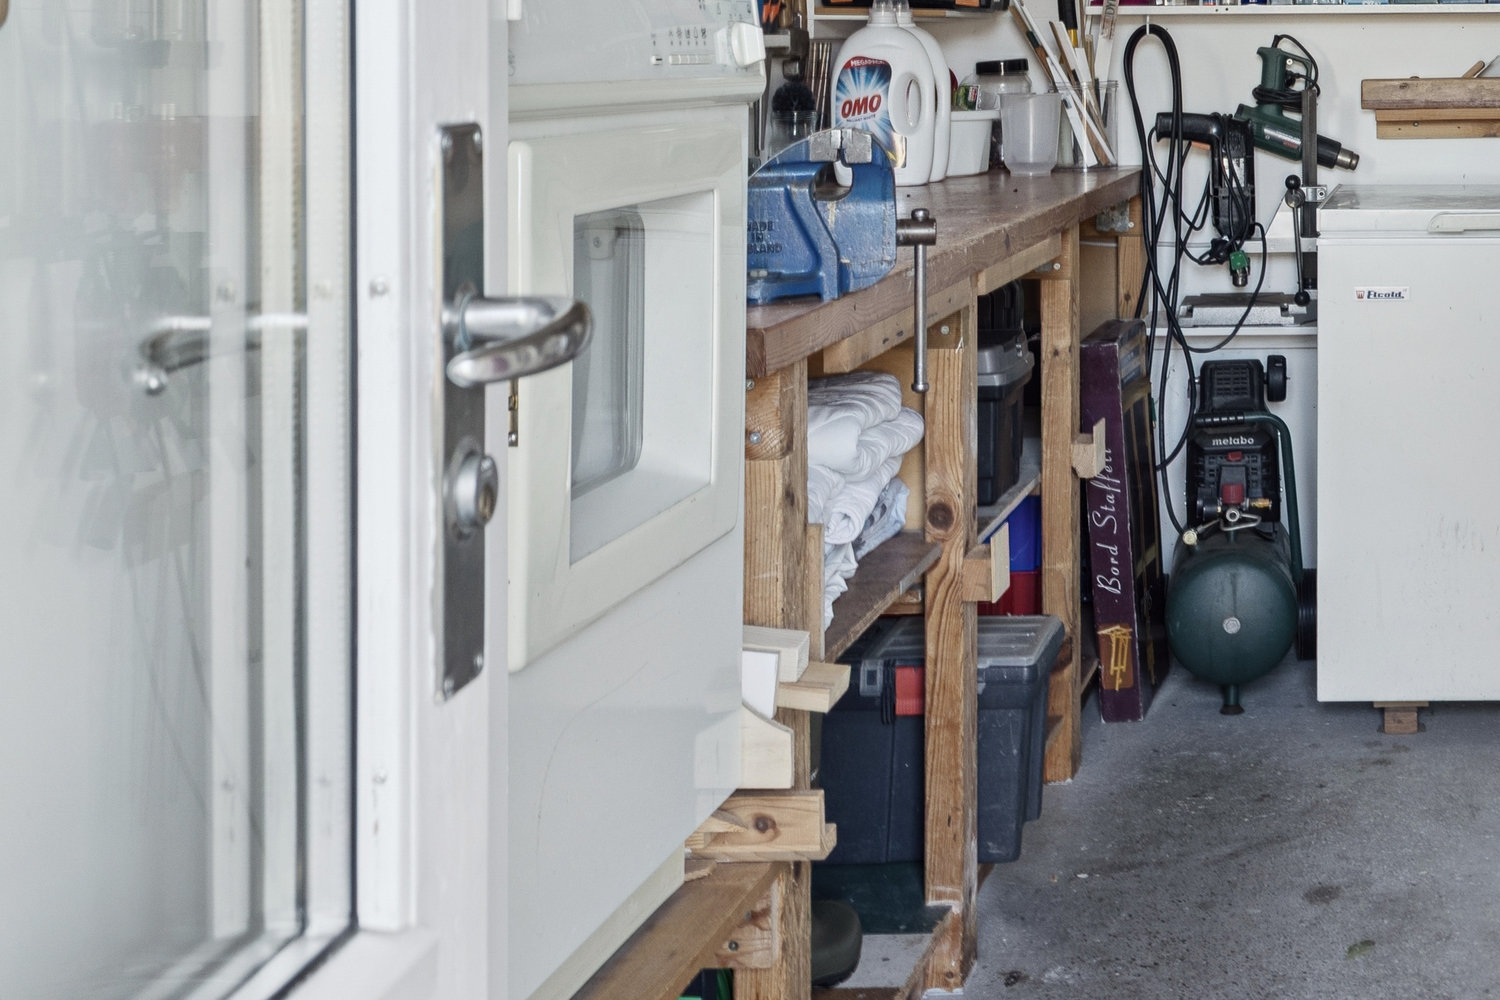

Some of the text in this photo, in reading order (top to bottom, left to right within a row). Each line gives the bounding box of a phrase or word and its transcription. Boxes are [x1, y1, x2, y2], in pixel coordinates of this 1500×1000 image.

[841, 94, 882, 118] OMO
[752, 232, 764, 242] IN
[747, 243, 783, 254] GLAND
[1212, 435, 1254, 446] metabo
[1095, 542, 1121, 594] Bord
